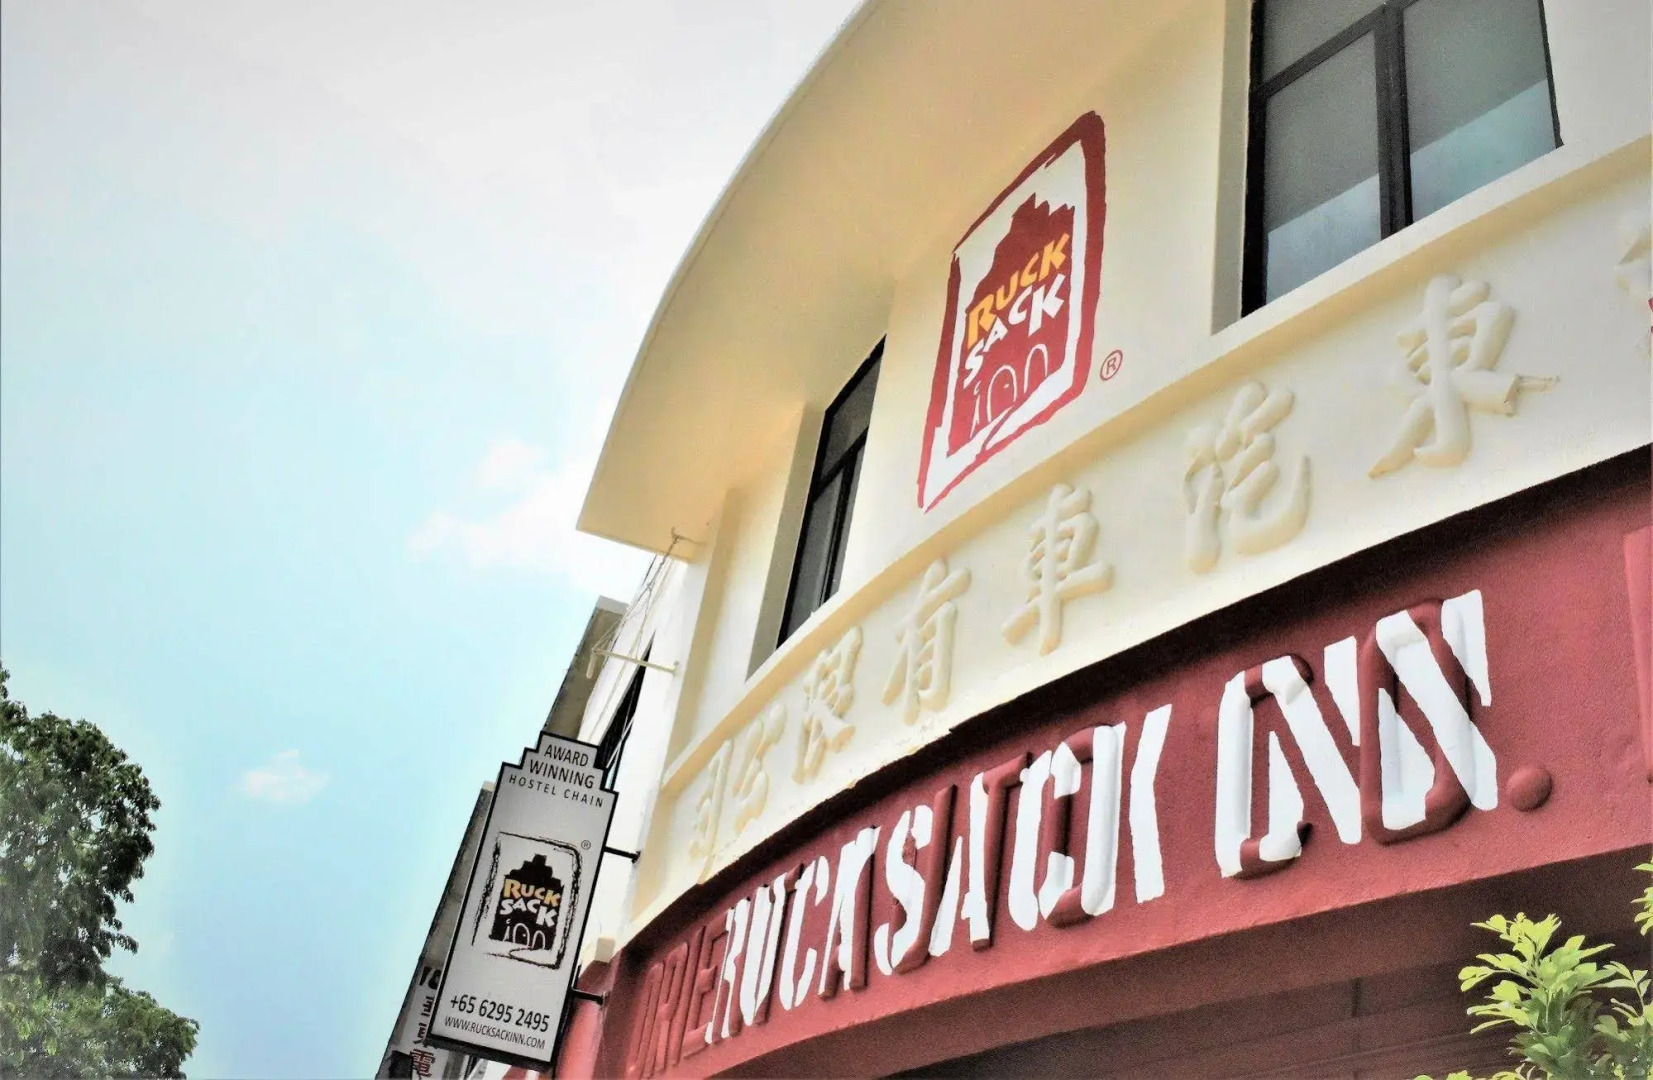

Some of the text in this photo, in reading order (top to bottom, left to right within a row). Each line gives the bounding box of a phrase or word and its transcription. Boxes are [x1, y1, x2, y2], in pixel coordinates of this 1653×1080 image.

[968, 233, 1070, 349] RUCK
[963, 273, 1066, 389] SACK
[1214, 589, 1498, 878] INN
[544, 744, 589, 767] AWARD
[509, 774, 603, 808] HOSTEL CHAIN
[529, 759, 595, 789] WINNING
[503, 878, 561, 907] RUCK
[500, 897, 557, 928] SACK
[450, 994, 550, 1032] +65 6295 2495
[444, 1015, 546, 1049] WWW.RUCKSACKINN.COM
